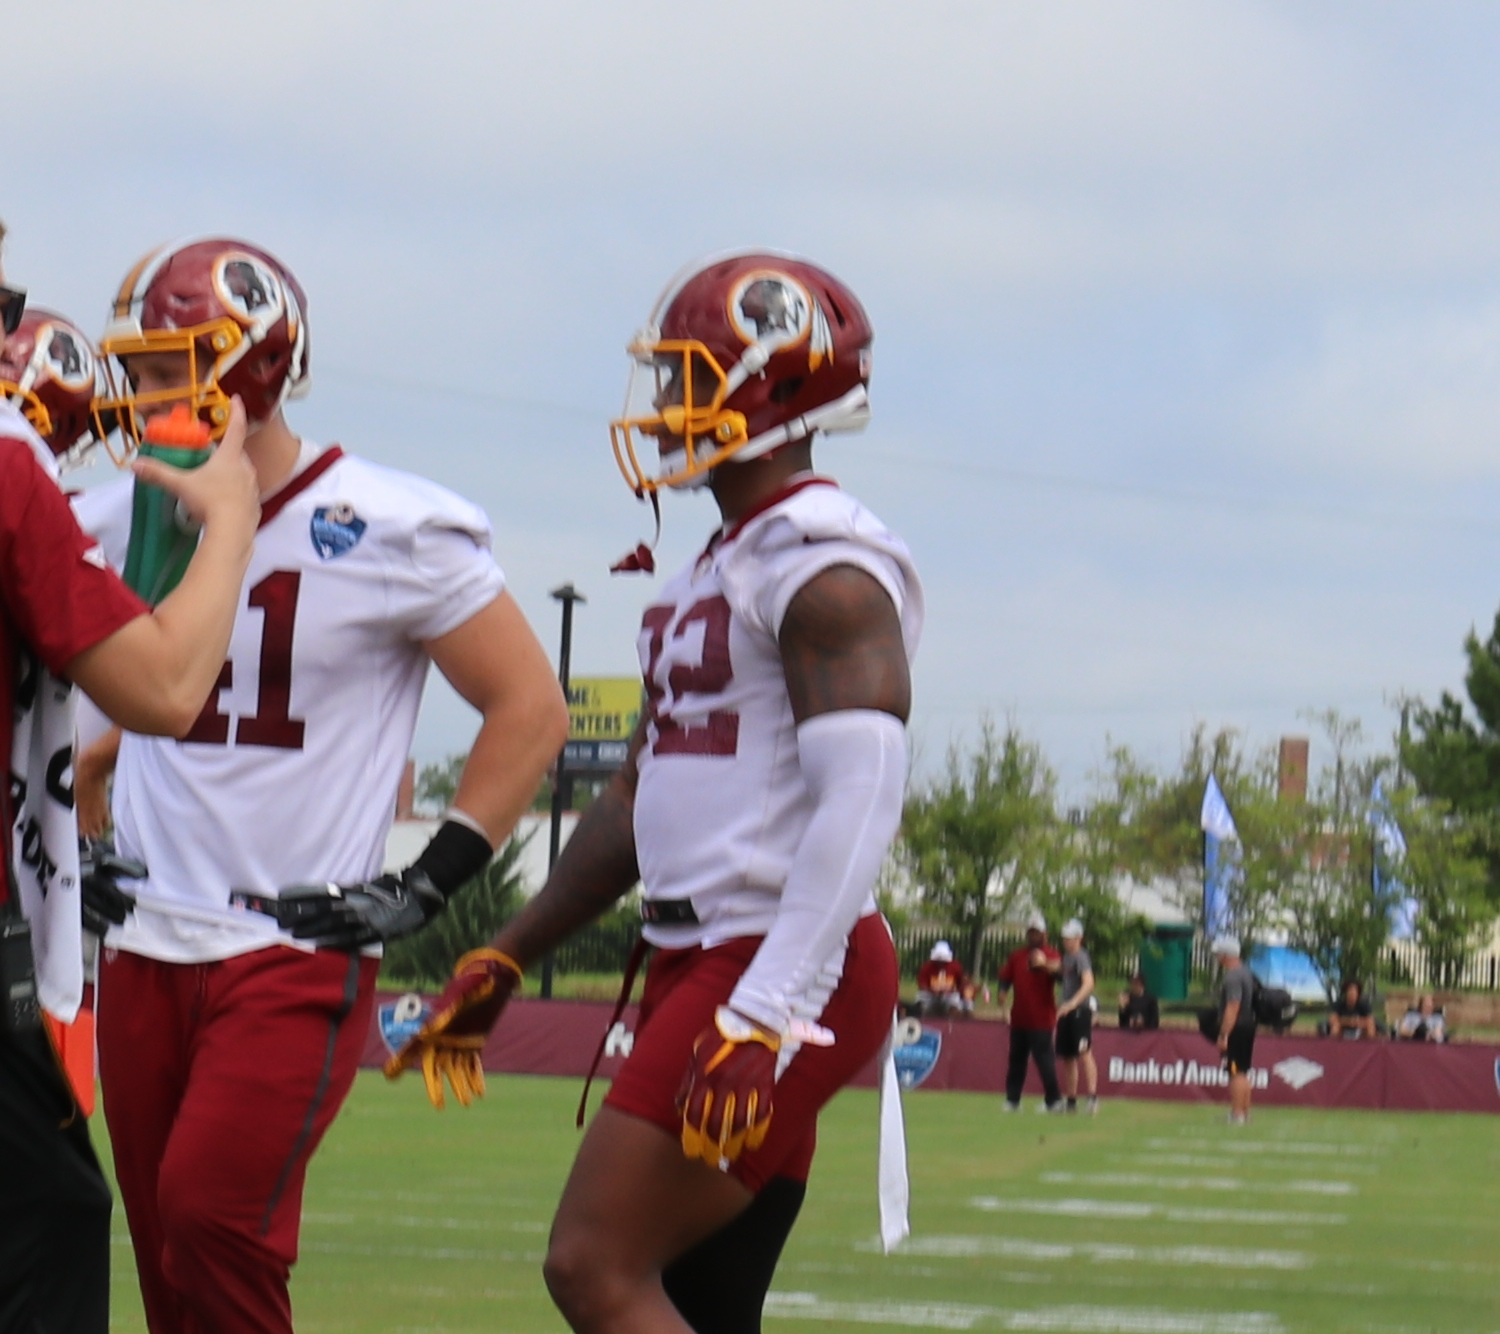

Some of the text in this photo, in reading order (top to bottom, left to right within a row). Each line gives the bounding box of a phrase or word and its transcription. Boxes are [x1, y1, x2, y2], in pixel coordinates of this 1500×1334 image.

[178, 570, 305, 749] 1
[1108, 1056, 1269, 1090] Bank of Ameca
